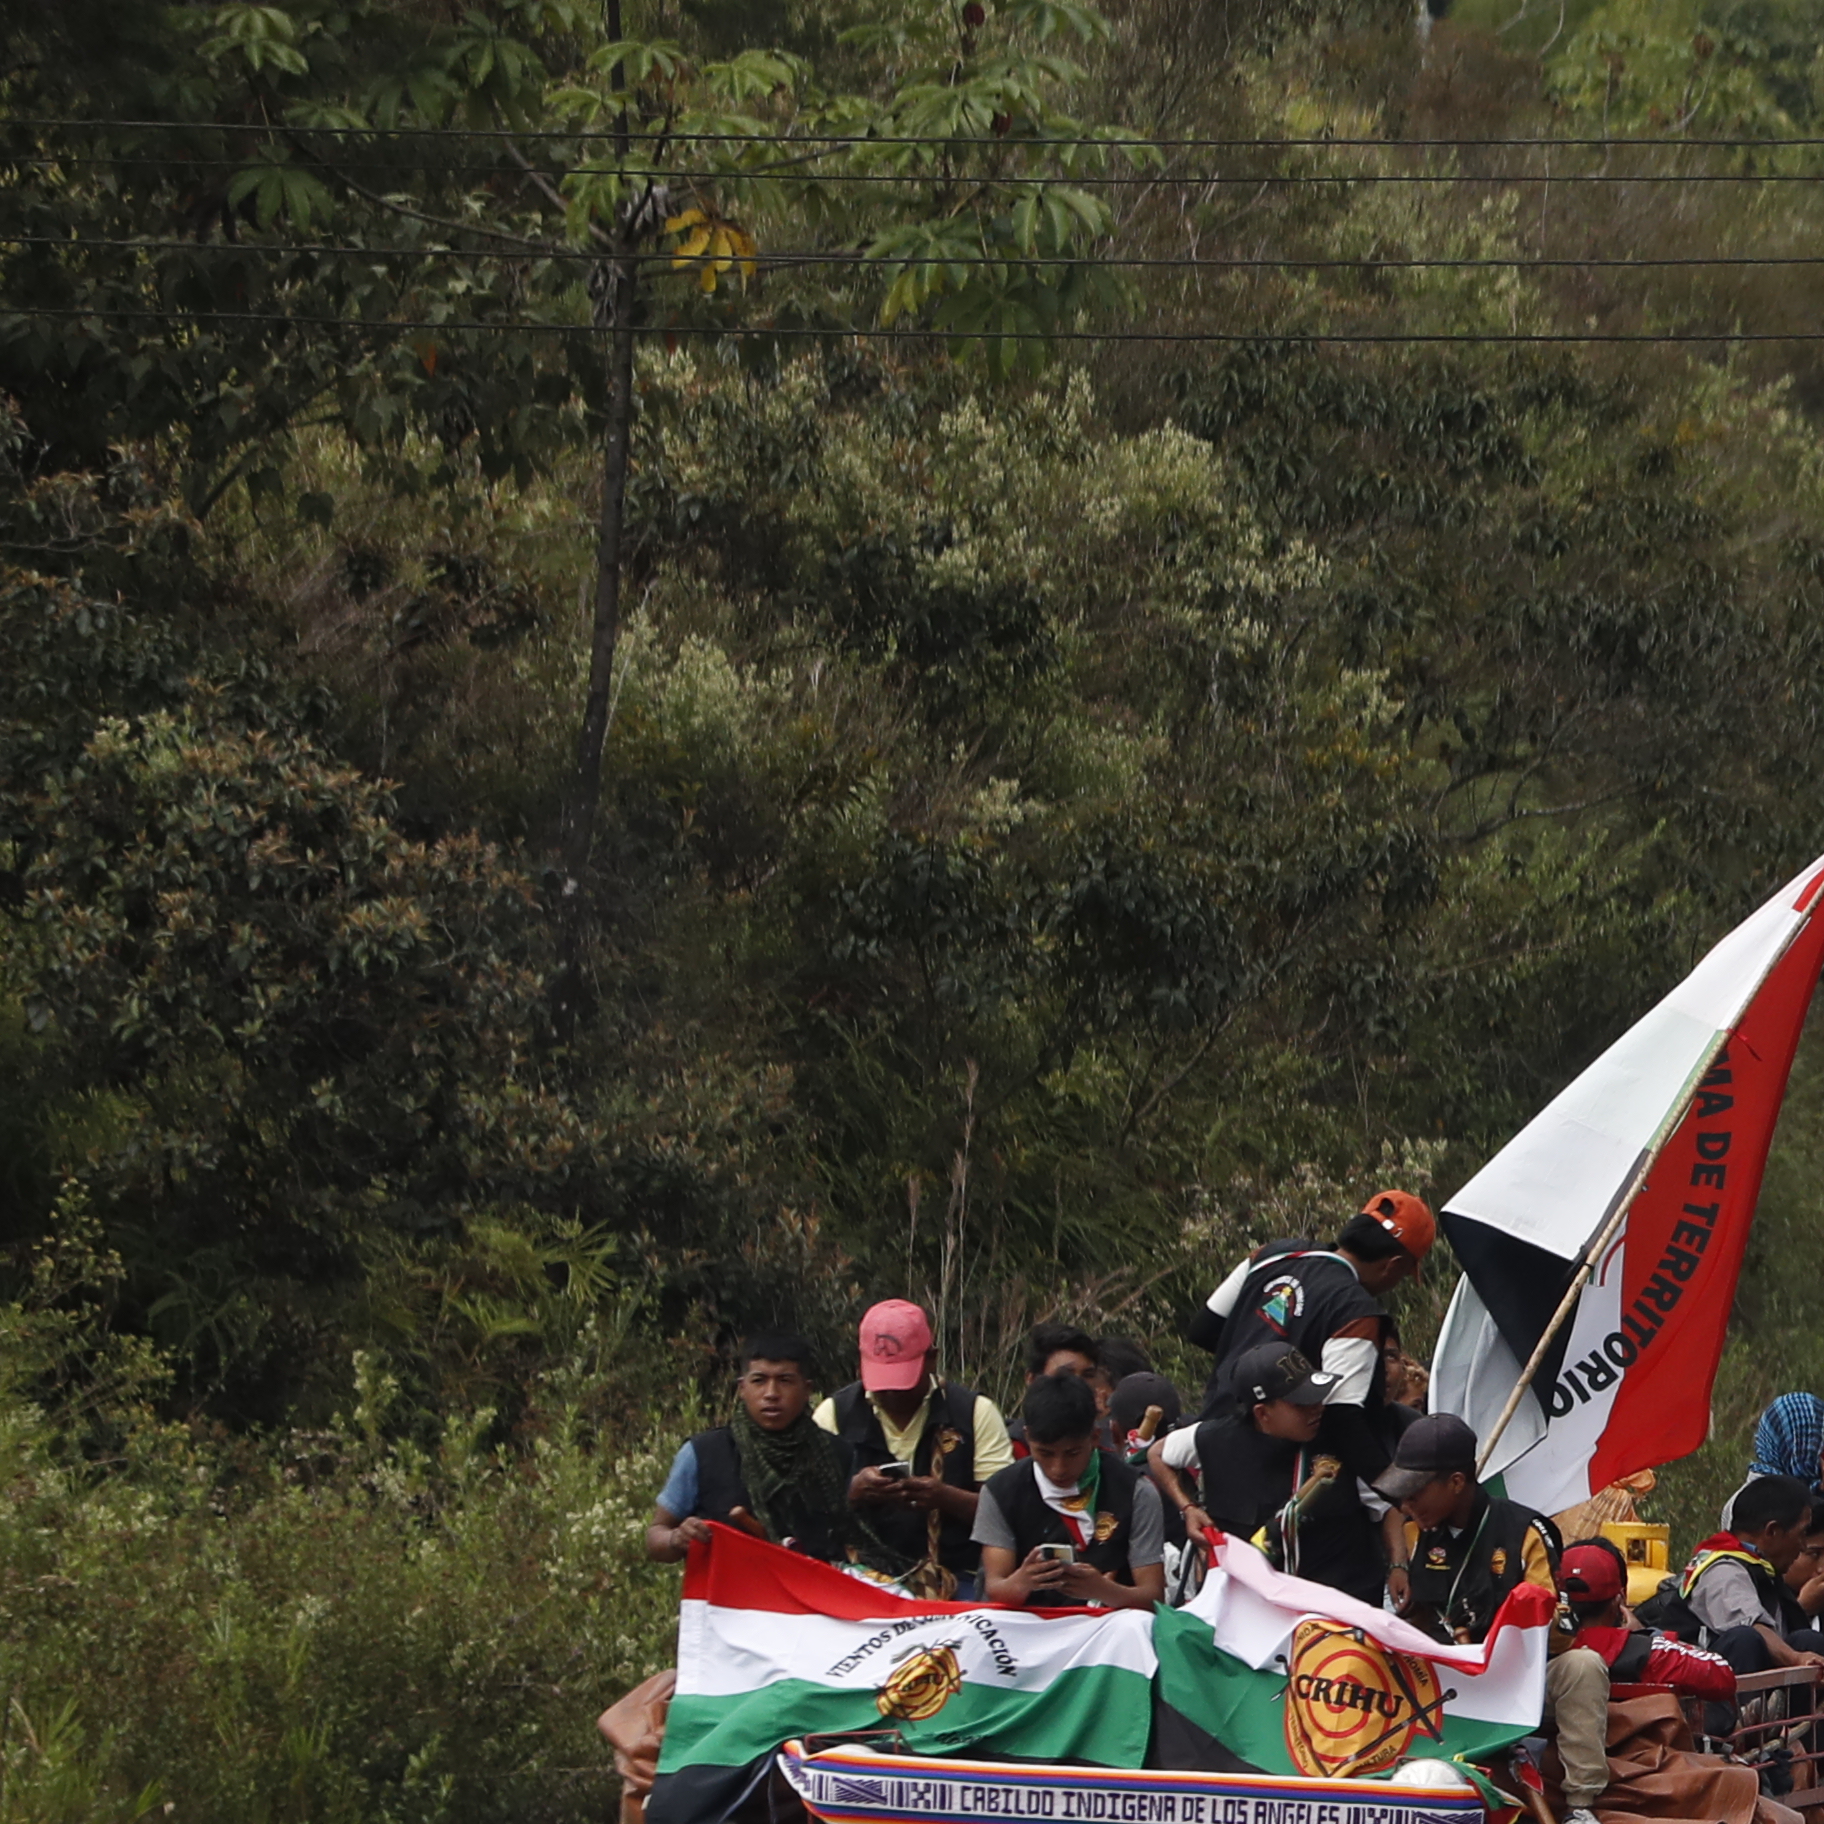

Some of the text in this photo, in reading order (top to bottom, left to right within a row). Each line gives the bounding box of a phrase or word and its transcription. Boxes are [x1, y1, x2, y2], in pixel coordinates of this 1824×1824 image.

[1690, 1131, 1732, 1191] DE
[1549, 1202, 1720, 1420] TERRITORIO
[910, 1612, 1018, 1678] COICACIÓN
[1296, 1673, 1404, 1719] CRIHU
[960, 1785, 1055, 1817] CABILDO
[1060, 1790, 1177, 1824] INDIGENA
[1181, 1796, 1206, 1824] DE
